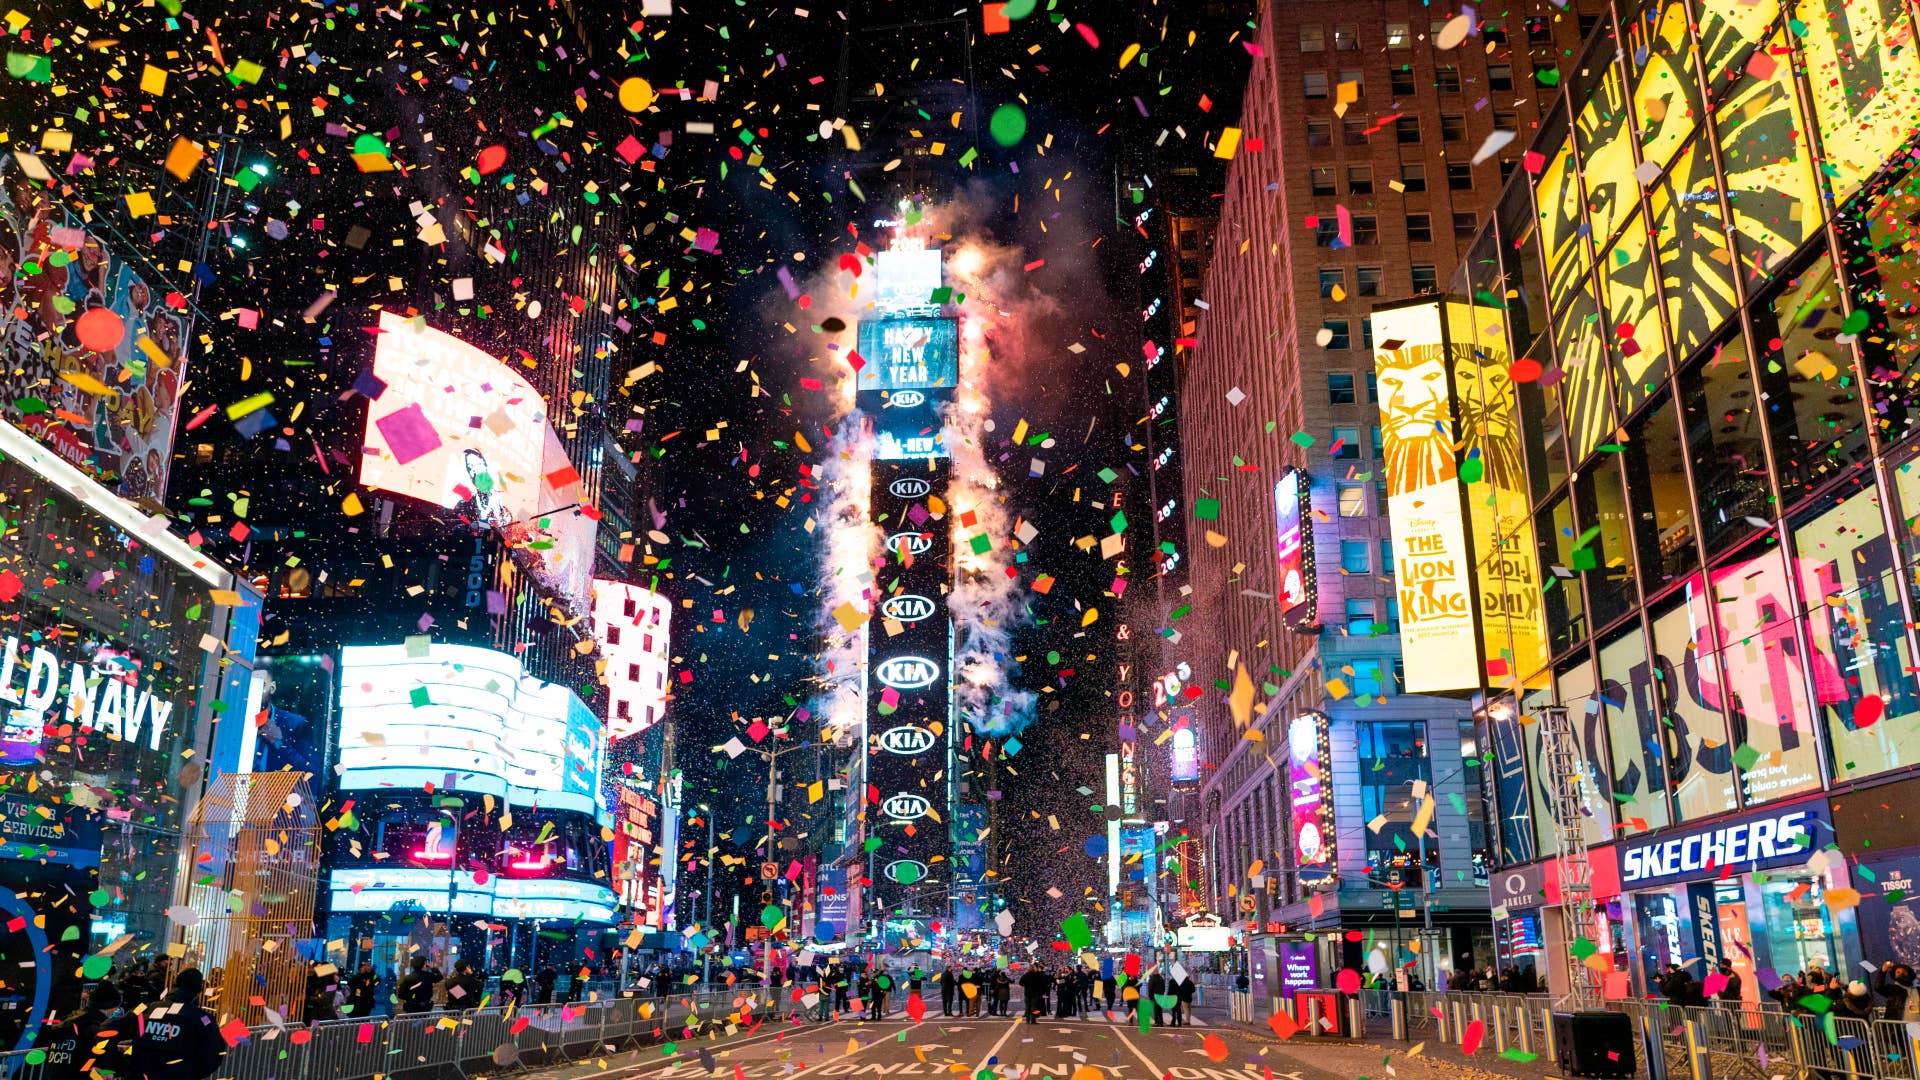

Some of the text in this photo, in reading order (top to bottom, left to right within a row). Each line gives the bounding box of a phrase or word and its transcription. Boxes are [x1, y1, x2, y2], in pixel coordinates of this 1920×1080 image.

[884, 327, 933, 345] HAPPY
[892, 348, 925, 363] NEW
[889, 366, 928, 383] YEAR
[897, 482, 923, 494] KIA
[1404, 533, 1444, 553] THE
[466, 538, 484, 607] 1500
[1400, 558, 1456, 588] LION
[890, 600, 927, 616] KIA
[1399, 588, 1467, 625] KING
[1117, 624, 1130, 640] &
[887, 663, 929, 681] KIA
[65, 662, 173, 751] NAVY
[1584, 625, 1748, 806] CBS
[890, 732, 925, 748] KIA
[891, 801, 922, 813] KIA
[3, 821, 62, 839] SERVICES
[1623, 812, 1810, 883] SKECHERS
[1881, 879, 1912, 891] TISSOT
[1503, 894, 1532, 906] OAKLEY
[1285, 978, 1314, 987] happens
[145, 1020, 181, 1038] NYPD
[817, 1062, 951, 1076] ONLY
